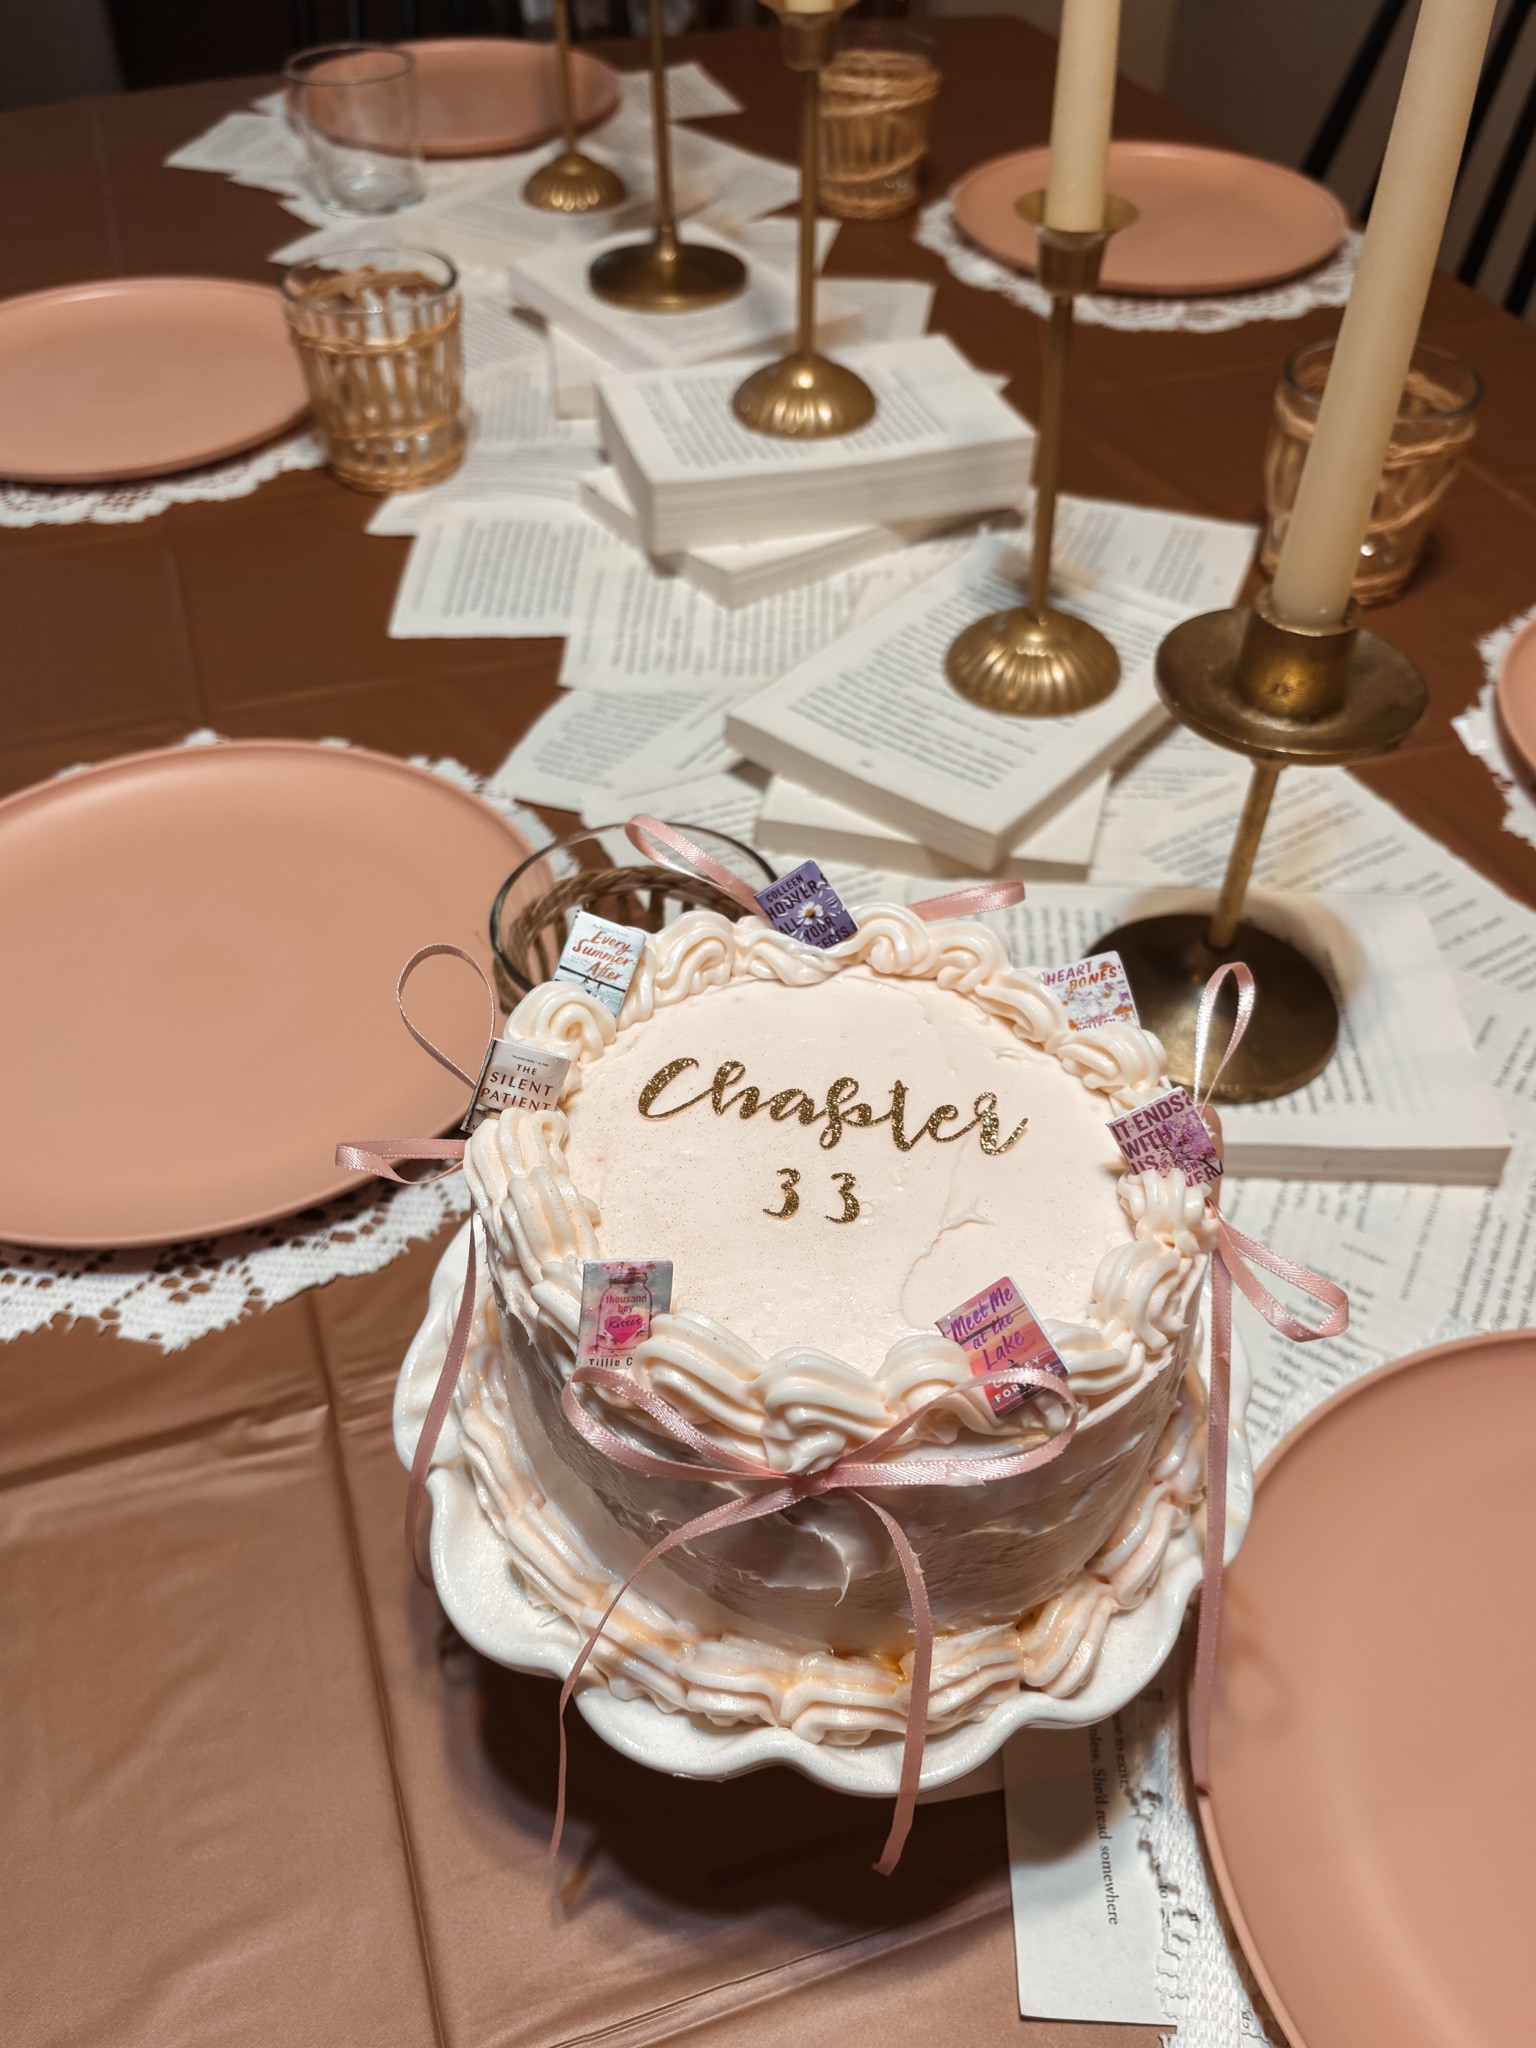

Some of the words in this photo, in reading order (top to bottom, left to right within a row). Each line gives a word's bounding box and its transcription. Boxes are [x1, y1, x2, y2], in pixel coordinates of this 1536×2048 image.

[765, 874, 804, 903] COLLEEN
[765, 879, 821, 922] HOOVER
[779, 917, 802, 936] ALL
[803, 916, 836, 942] YOUR
[572, 938, 634, 966] Summer
[590, 930, 633, 956] Every
[585, 961, 624, 981] After
[1046, 960, 1093, 985] HEART
[1069, 966, 1117, 990] BONES
[516, 1063, 538, 1076] THE
[489, 1071, 554, 1097] SILENT
[480, 1086, 552, 1112] PATIENT
[637, 1057, 1029, 1156] Chapter
[1111, 1120, 1132, 1142] IT
[1131, 1094, 1186, 1132] ENDS
[1120, 1124, 1173, 1160] WITH
[606, 1293, 647, 1304] thousand
[617, 1304, 634, 1313] boy
[948, 1302, 989, 1343] Meet
[988, 1286, 1014, 1313] Me
[972, 1330, 988, 1350] at
[991, 1313, 1014, 1335] the
[588, 1358, 621, 1367] Tillie
[982, 1330, 1025, 1371] Lake
[1115, 1738, 1126, 1752] to
[1096, 1810, 1113, 1840] read
[1100, 1844, 1120, 1926] somewhere
